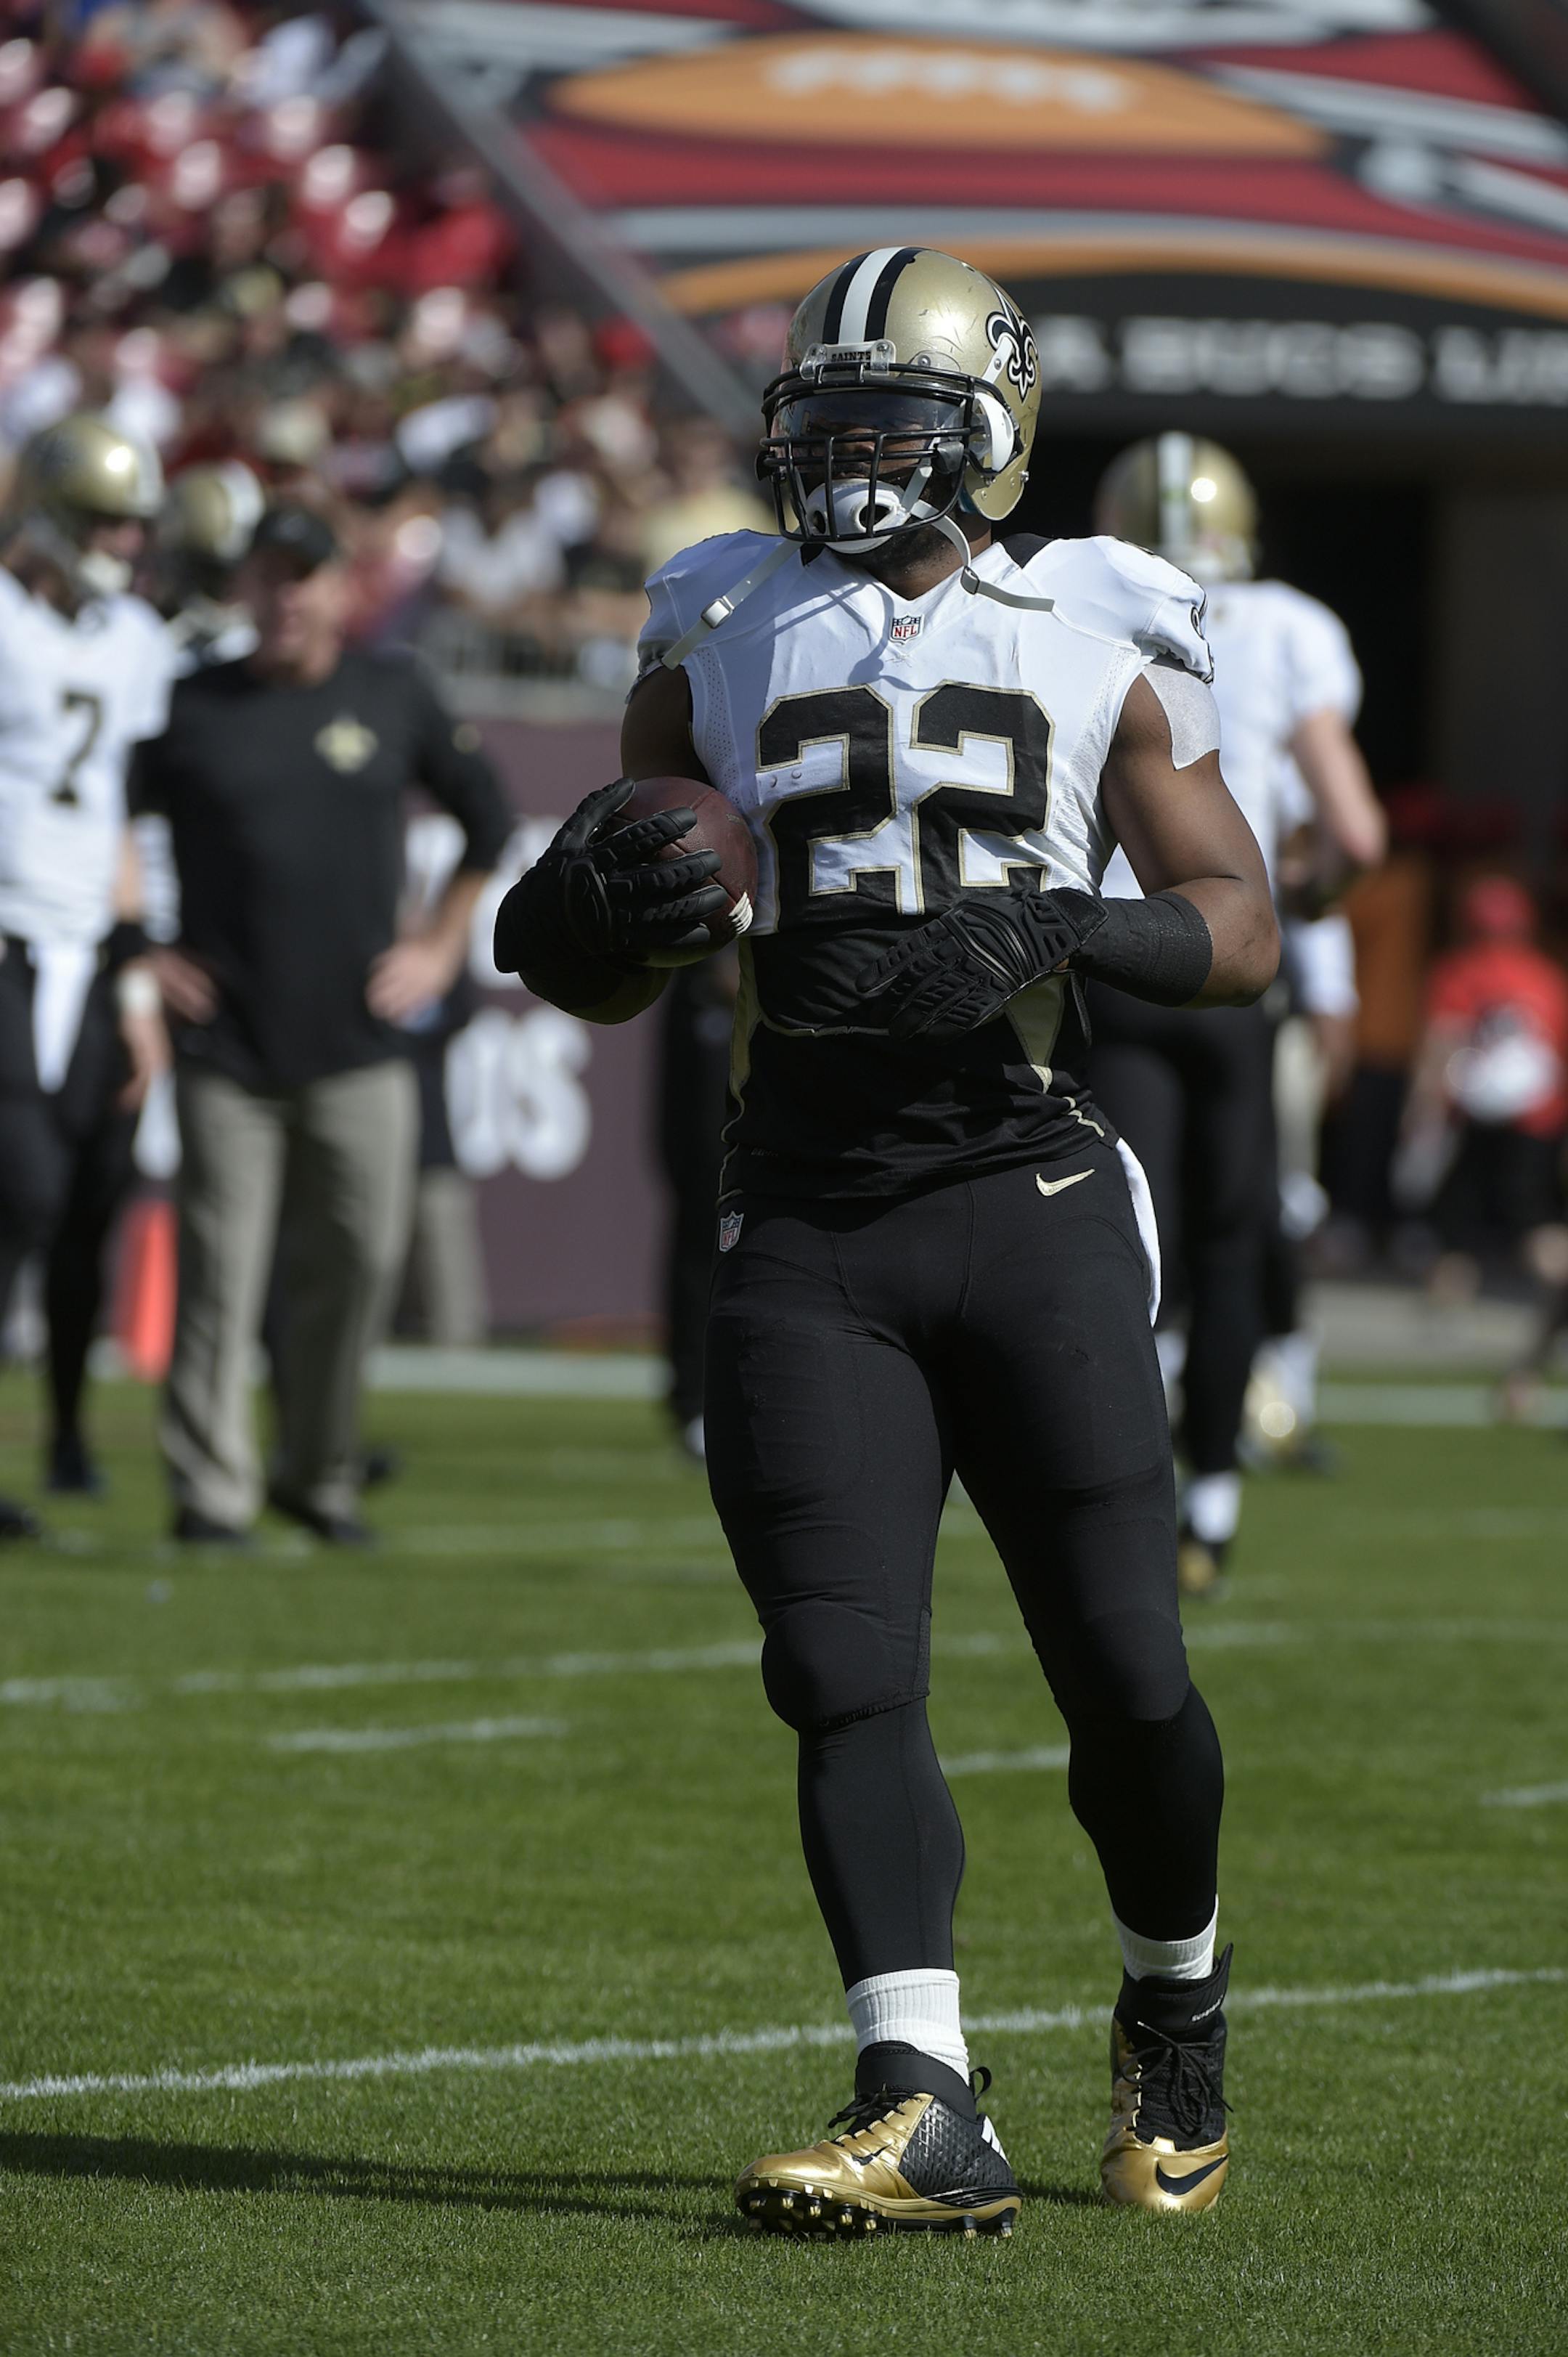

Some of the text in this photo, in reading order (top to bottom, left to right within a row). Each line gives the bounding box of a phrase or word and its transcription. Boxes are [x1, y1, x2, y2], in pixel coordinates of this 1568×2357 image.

[830, 351, 871, 362] SAINTS
[894, 625, 917, 638] NFL
[54, 688, 103, 805] 7
[756, 680, 1055, 933] 22
